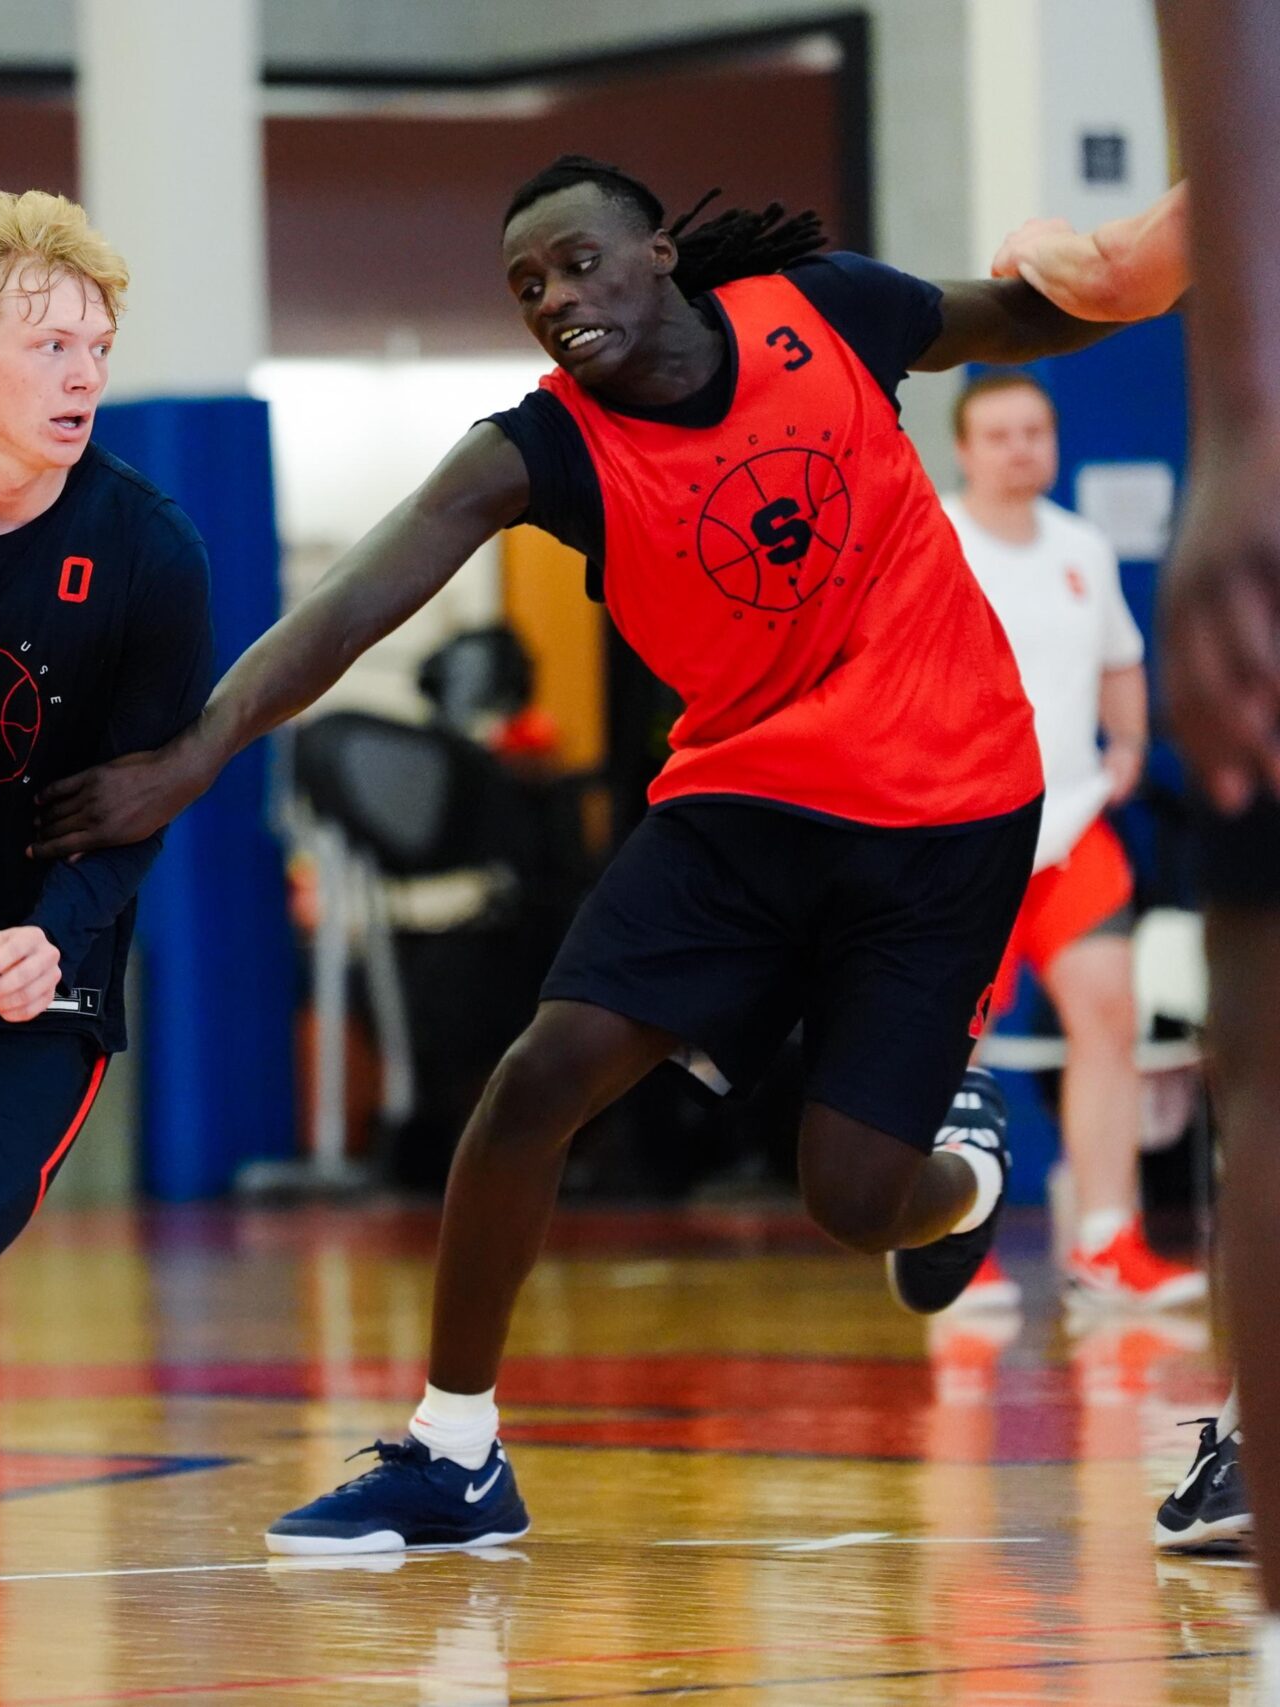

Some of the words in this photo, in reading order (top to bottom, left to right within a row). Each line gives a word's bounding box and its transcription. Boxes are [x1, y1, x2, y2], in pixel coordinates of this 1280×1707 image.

[766, 326, 813, 371] 3
[750, 497, 813, 566] S
[86, 995, 94, 1008] L
